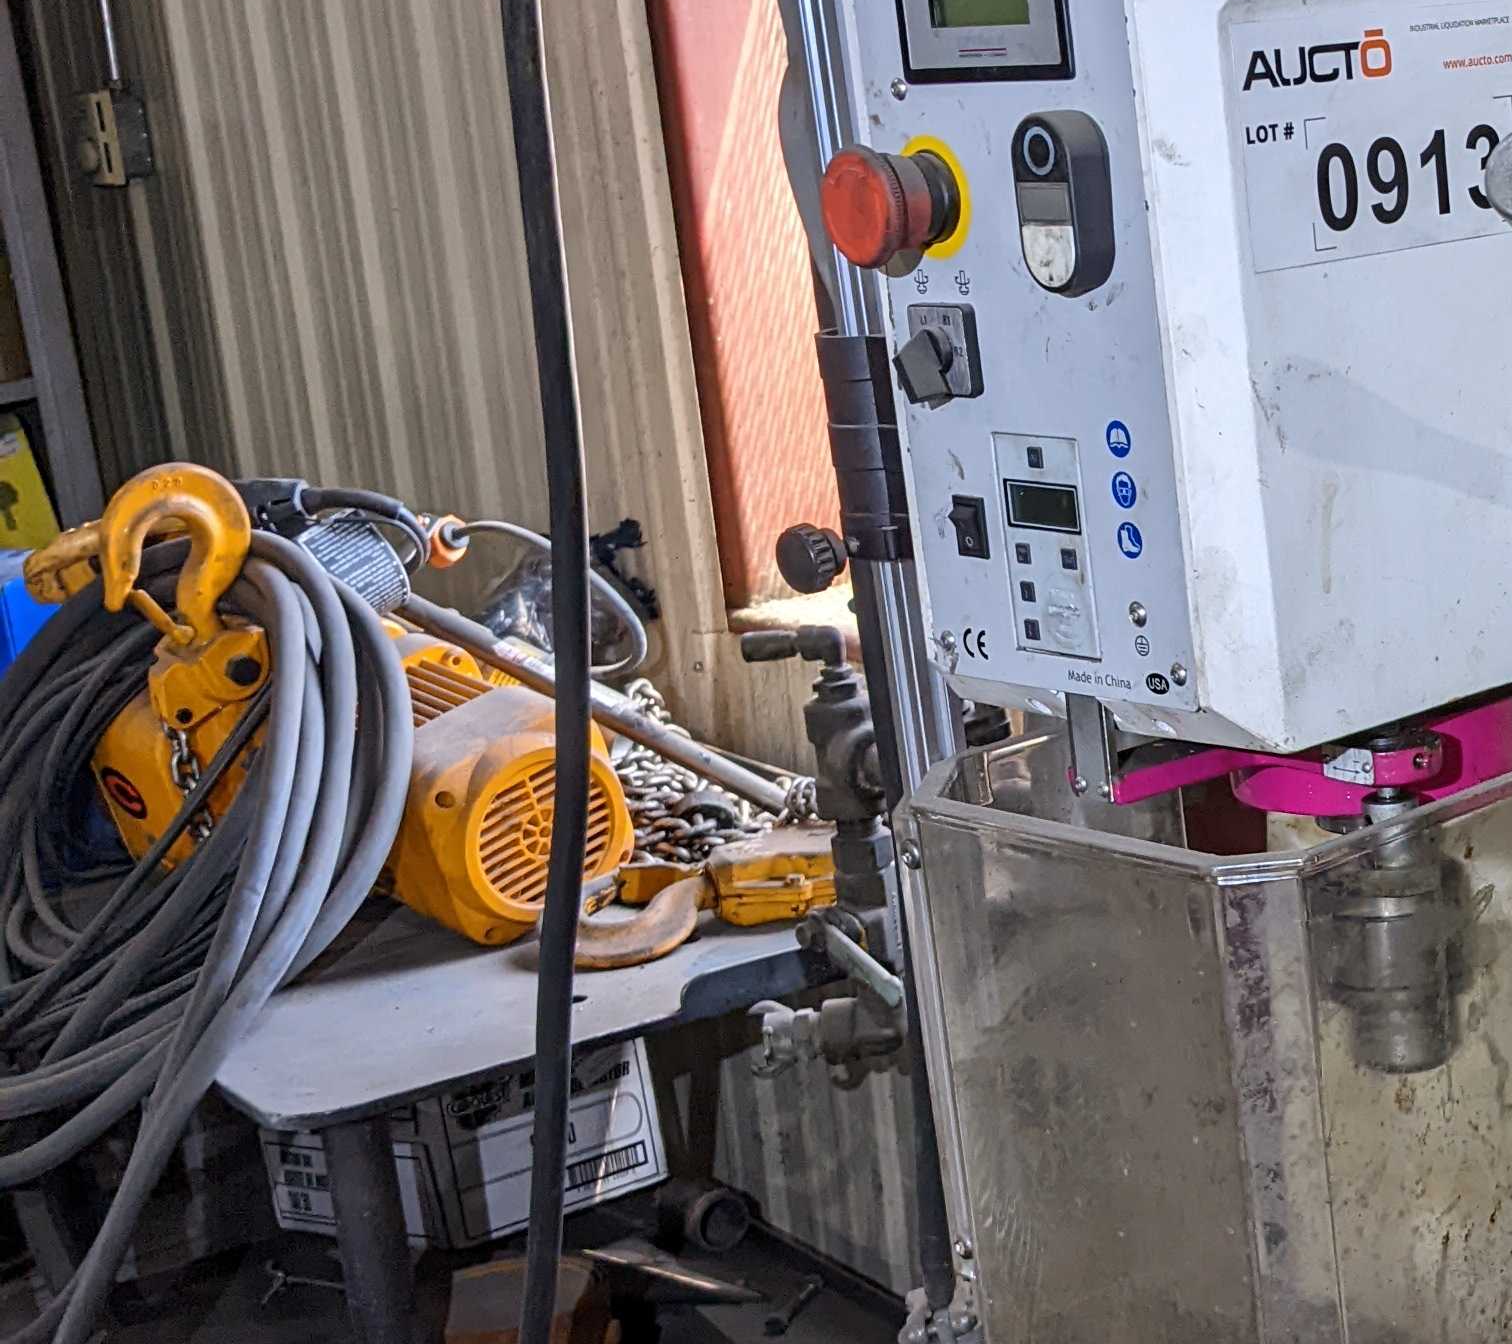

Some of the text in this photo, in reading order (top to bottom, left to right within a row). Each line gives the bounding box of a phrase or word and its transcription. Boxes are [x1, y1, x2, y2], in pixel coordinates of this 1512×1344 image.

[1442, 53, 1512, 70] www.aucto.com
[1246, 122, 1295, 145] LOT #
[1317, 124, 1501, 232] 0913
[963, 627, 989, 660] CE
[1067, 670, 1132, 690] Made in China
[1148, 677, 1168, 691] USA
